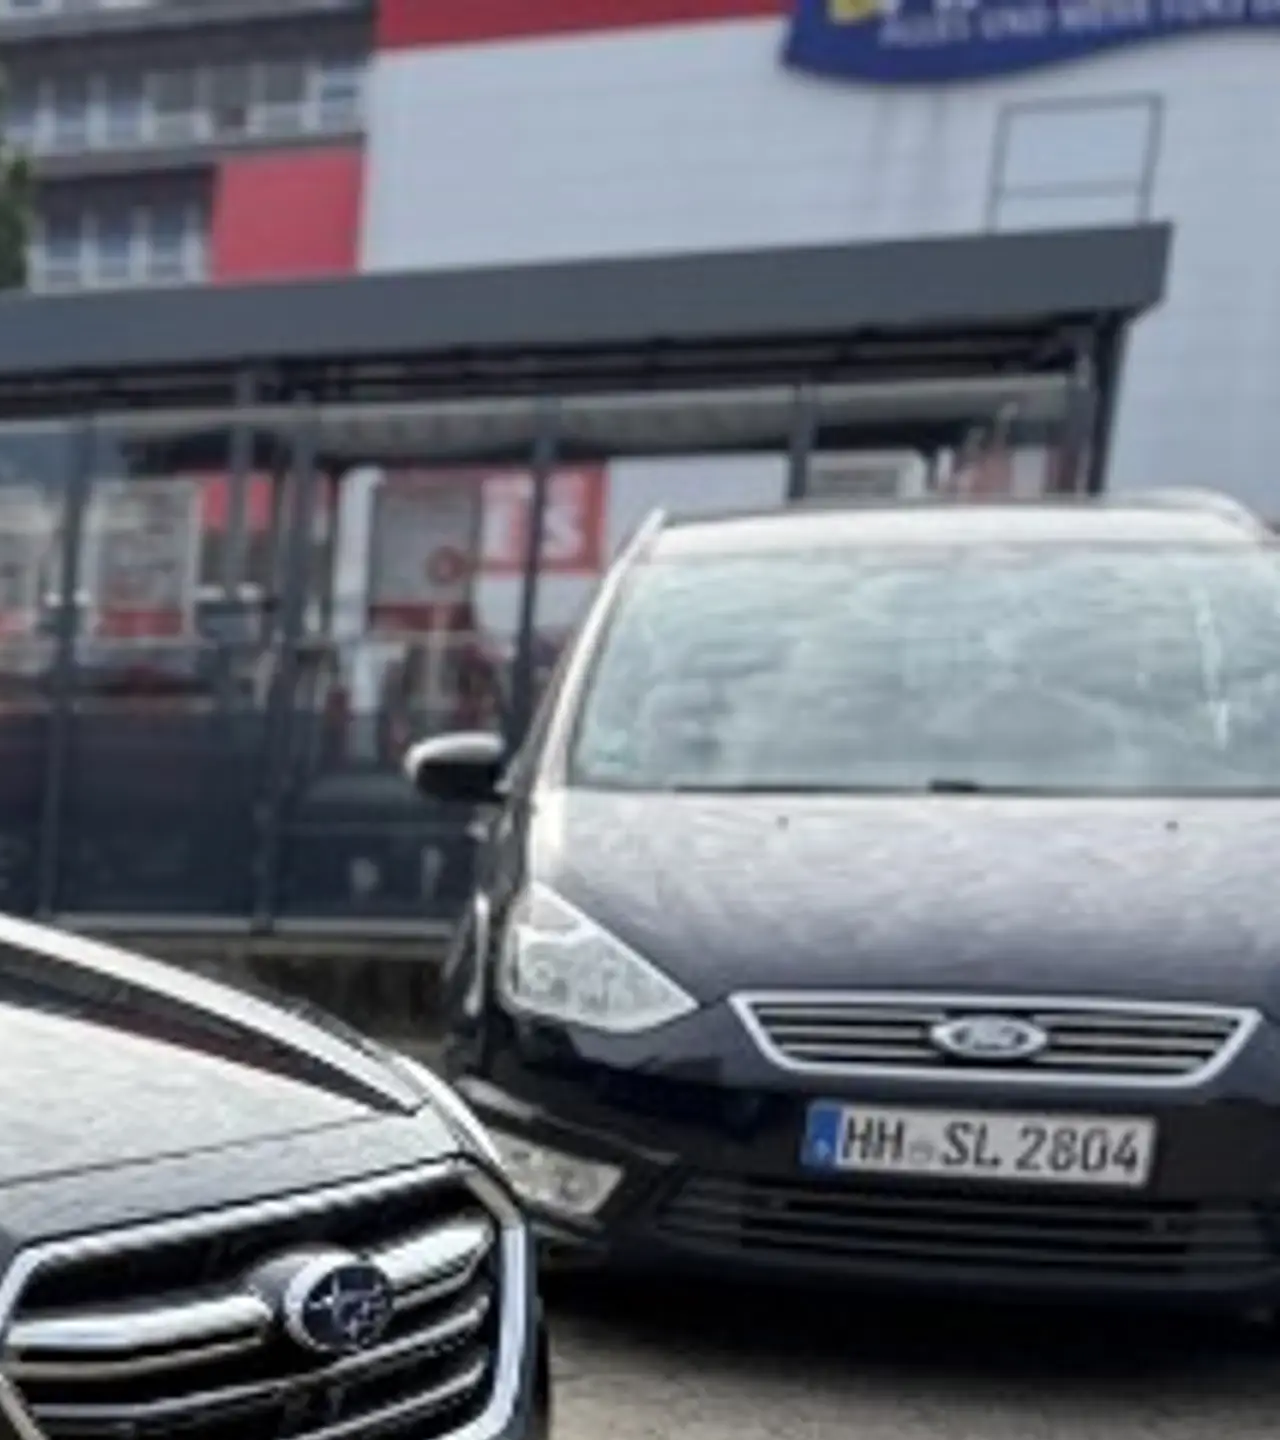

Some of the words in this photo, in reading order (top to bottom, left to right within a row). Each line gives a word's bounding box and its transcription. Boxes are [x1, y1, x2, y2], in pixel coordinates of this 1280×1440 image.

[841, 1116, 906, 1160] HH
[942, 1121, 1001, 1168] SL
[1015, 1125, 1140, 1174] 2804
